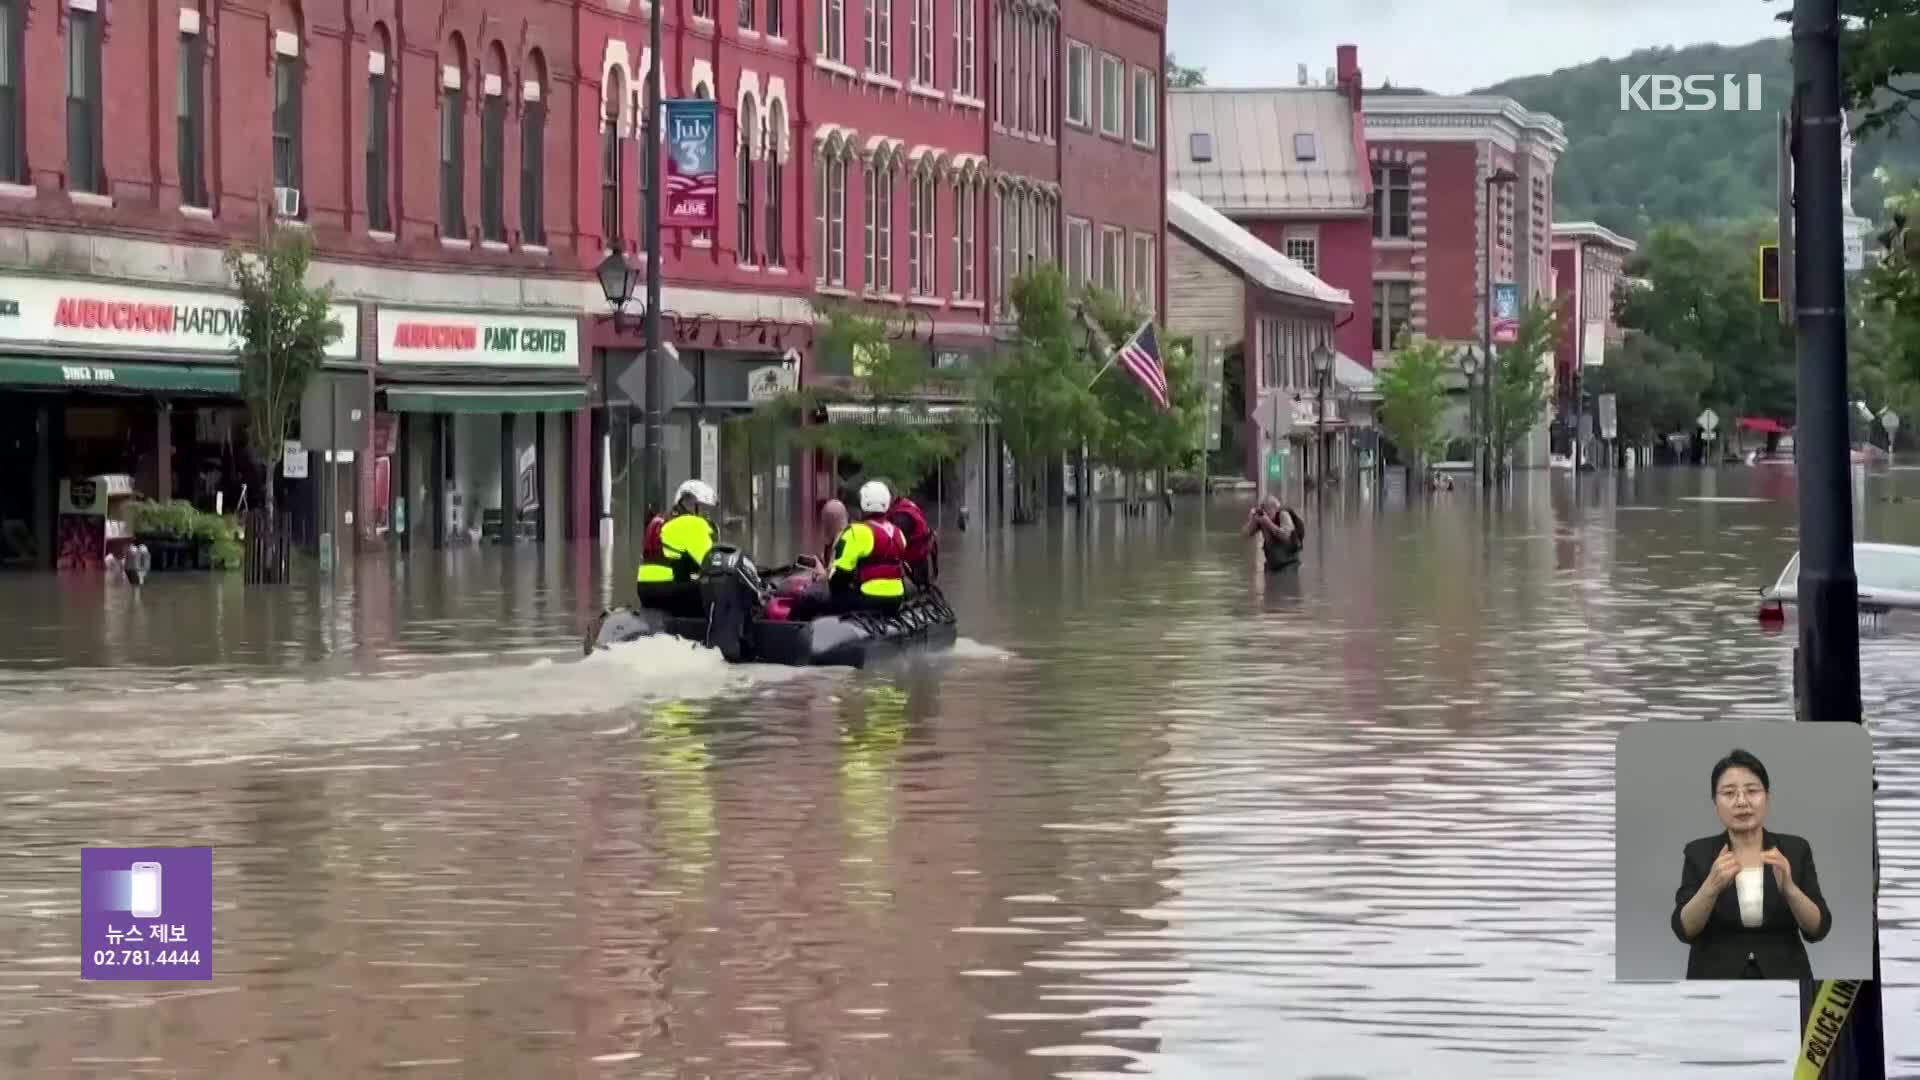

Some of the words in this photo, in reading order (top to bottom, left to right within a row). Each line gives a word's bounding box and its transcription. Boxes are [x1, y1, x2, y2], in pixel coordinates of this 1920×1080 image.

[672, 119, 711, 144] July
[673, 203, 707, 216] ALIVE
[54, 297, 173, 336] AUBUCHON
[173, 304, 249, 335] HARDW
[394, 322, 477, 349] AUBUCHON
[484, 326, 519, 352] PAINT
[521, 328, 567, 353] CENTER
[61, 366, 91, 380] SINCE
[1806, 1005, 1844, 1068] POLICE
[1827, 979, 1860, 1009] LIN
